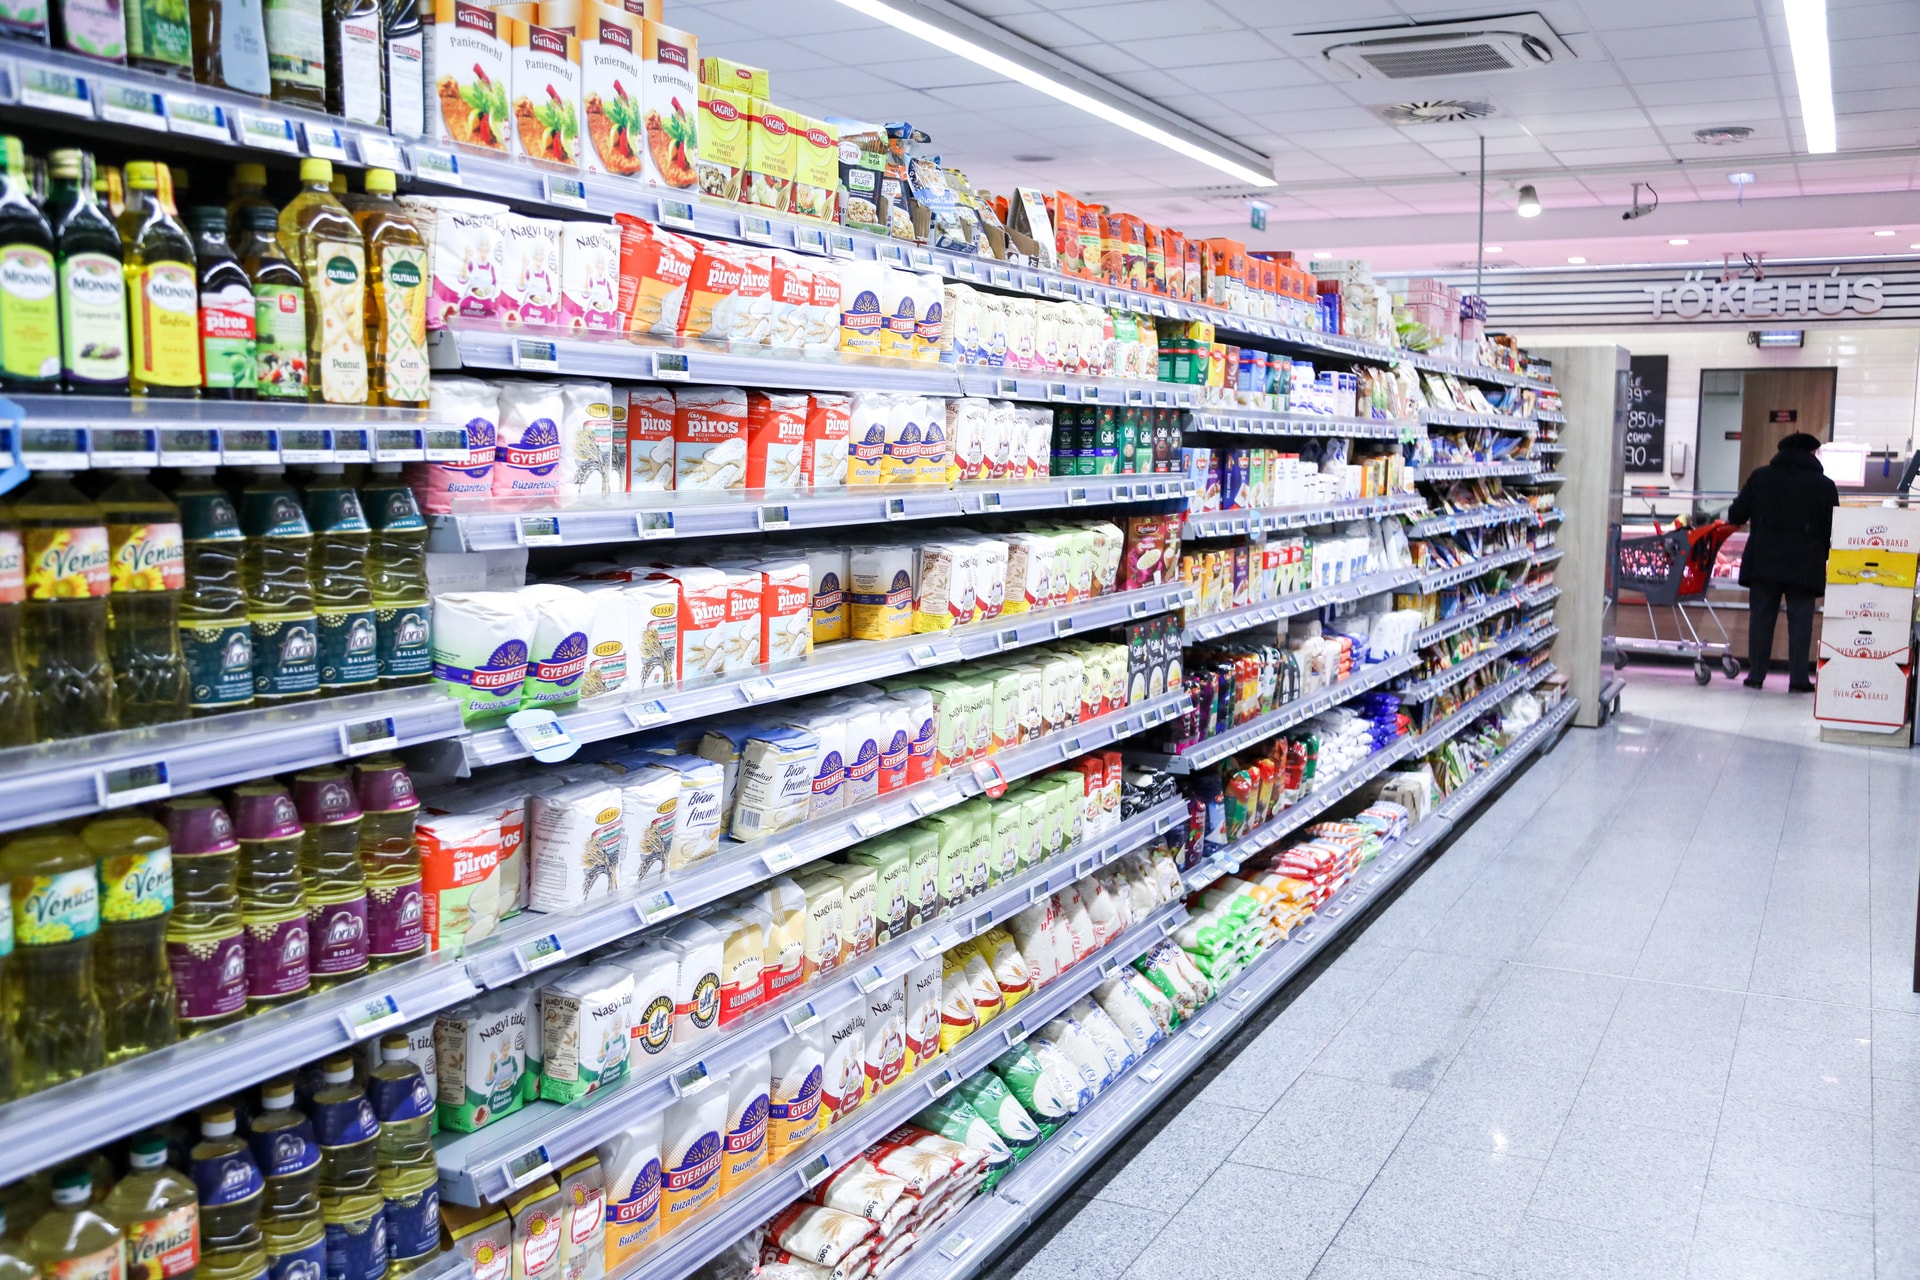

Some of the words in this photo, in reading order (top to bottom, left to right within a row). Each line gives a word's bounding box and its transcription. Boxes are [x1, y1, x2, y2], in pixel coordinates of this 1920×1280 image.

[450, 35, 503, 62] Paniermehl
[525, 58, 573, 82] Paniermehl
[593, 55, 639, 78] Paniermehl
[652, 73, 694, 94] Paniermehl
[712, 102, 735, 118] LAGRIS
[765, 116, 785, 132] LAGRIS
[808, 130, 829, 145] LAGRIS
[327, 269, 358, 281] OLITALIA
[392, 272, 420, 284] OLITALIA
[707, 265, 741, 286] piros
[73, 277, 120, 293] MONINI
[1643, 265, 1885, 320] TŐKEHÚS
[206, 313, 247, 332] piros
[332, 358, 361, 370] Peanut
[400, 359, 419, 369] Corn
[640, 413, 672, 435] piros
[687, 415, 739, 437] piros
[1866, 525, 1888, 536] Chio
[1847, 537, 1866, 545] OVEN
[1886, 538, 1909, 547] BAKED
[731, 594, 759, 617] piros
[778, 589, 806, 611] piros
[692, 601, 726, 625] piros
[1833, 689, 1854, 699] OVEN
[1868, 691, 1889, 701] BAKED
[453, 850, 498, 882] piros
[333, 948, 355, 957] BODY
[592, 999, 622, 1022] Nagyi
[479, 1017, 509, 1042] Nagyi
[865, 1205, 874, 1218] 500
[817, 1248, 827, 1264] 500
